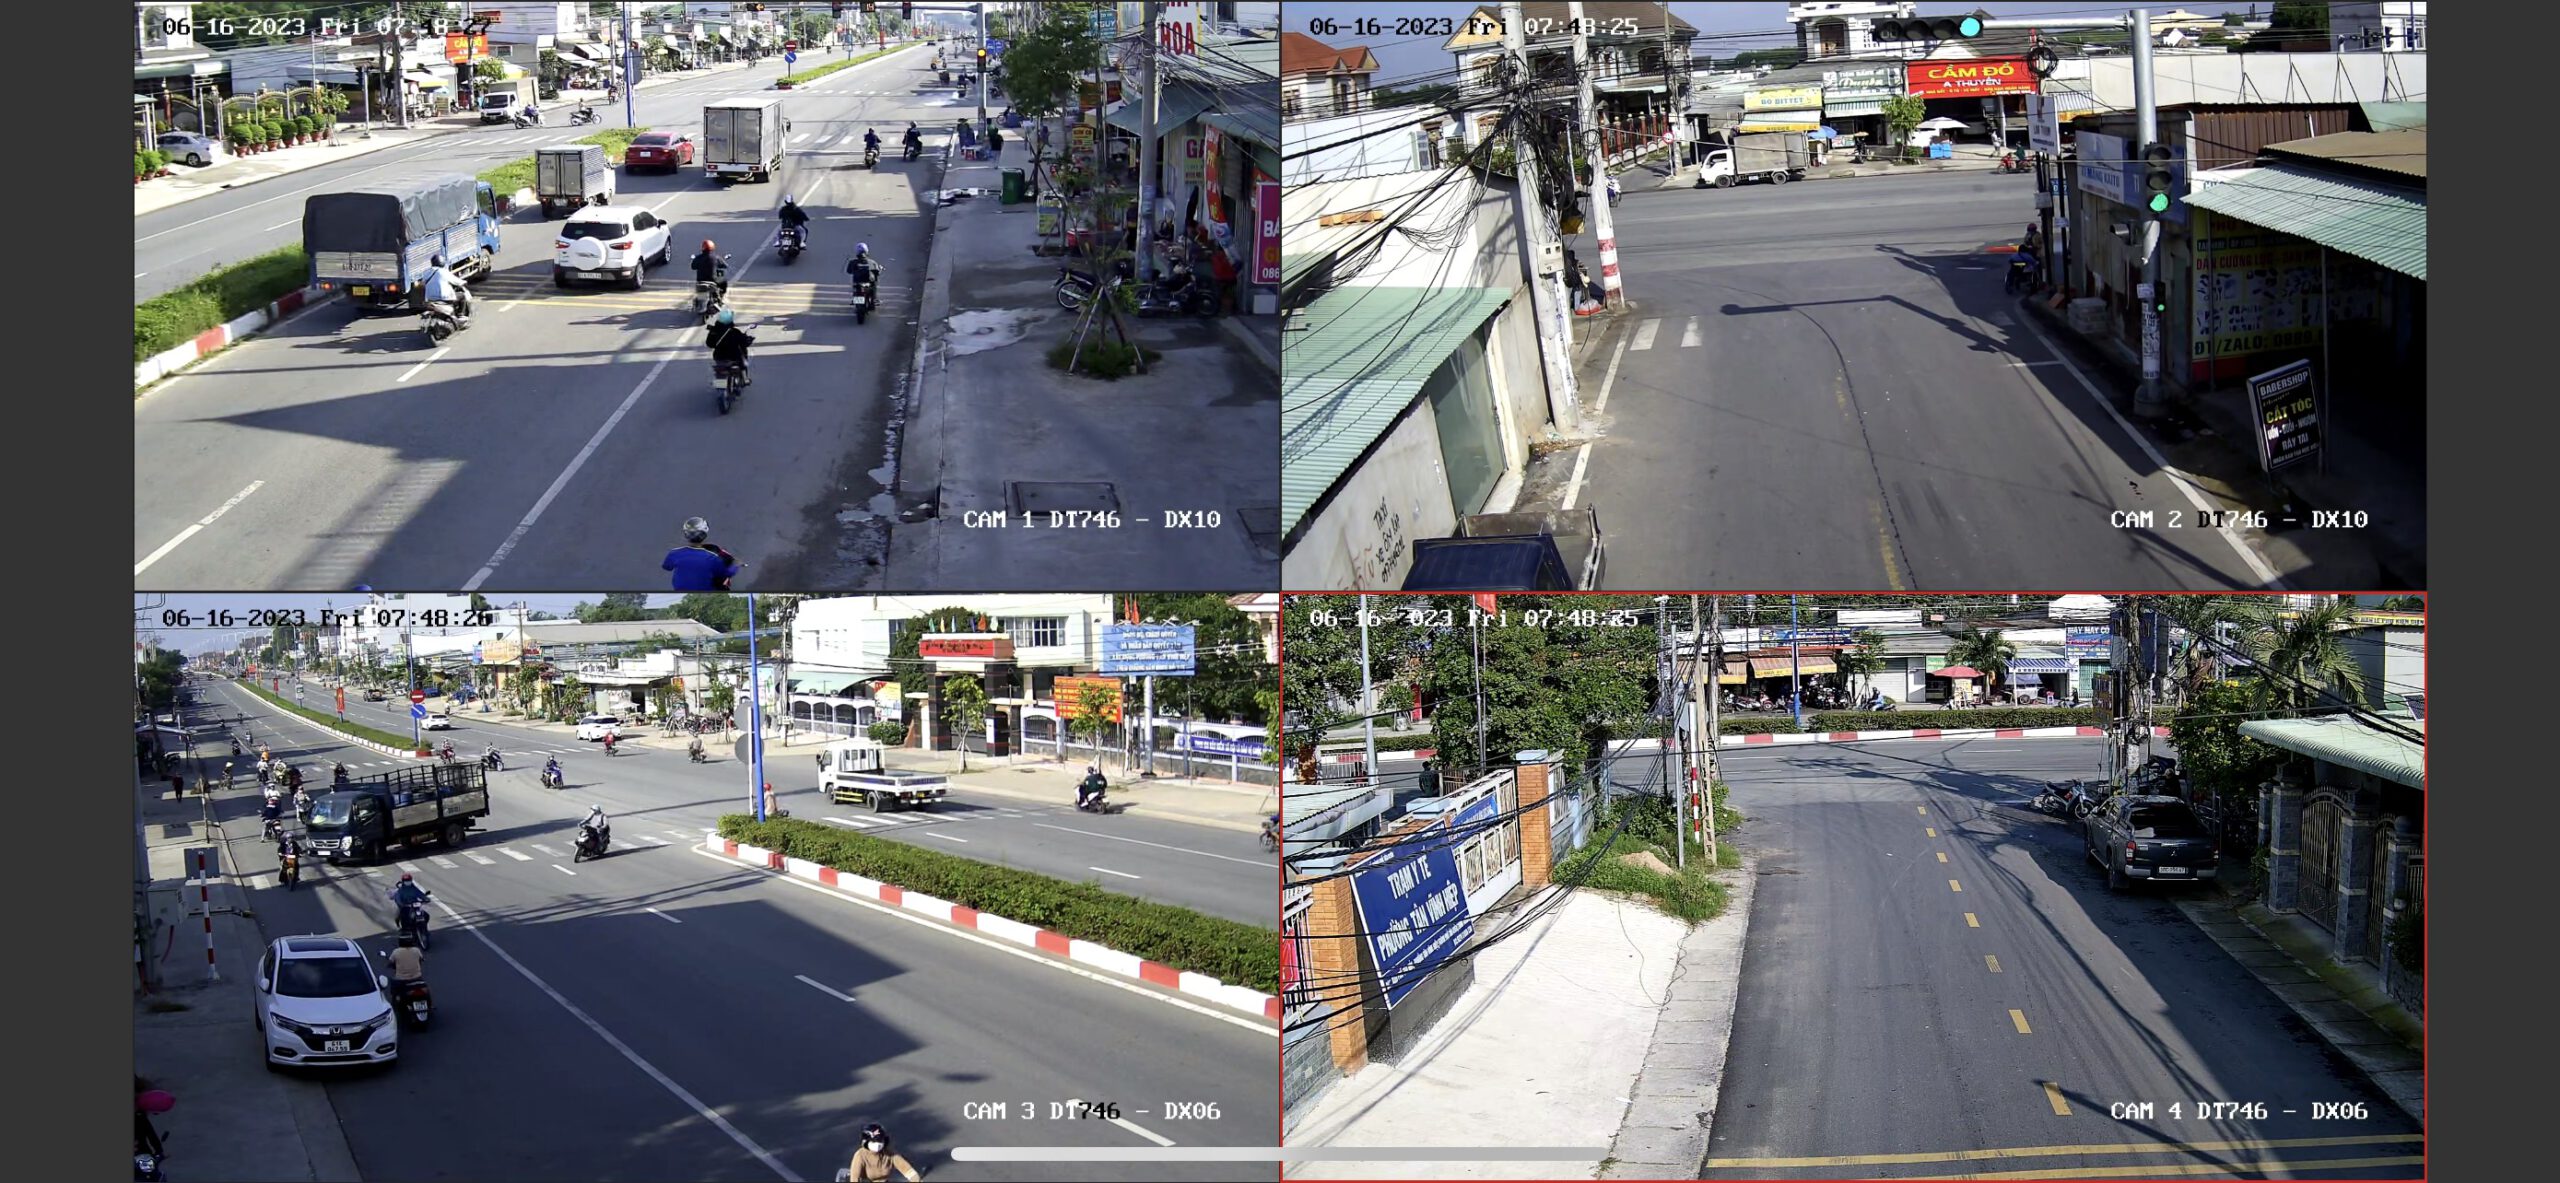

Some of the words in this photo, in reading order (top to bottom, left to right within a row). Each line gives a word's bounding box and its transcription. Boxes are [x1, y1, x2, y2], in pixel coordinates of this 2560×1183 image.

[2260, 371, 2309, 396] BABERSHOP
[1387, 861, 1415, 899] TRẠM
[1411, 860, 1420, 885] Y
[1410, 903, 1430, 936] TÂN
[1425, 892, 1447, 924] VĨNH
